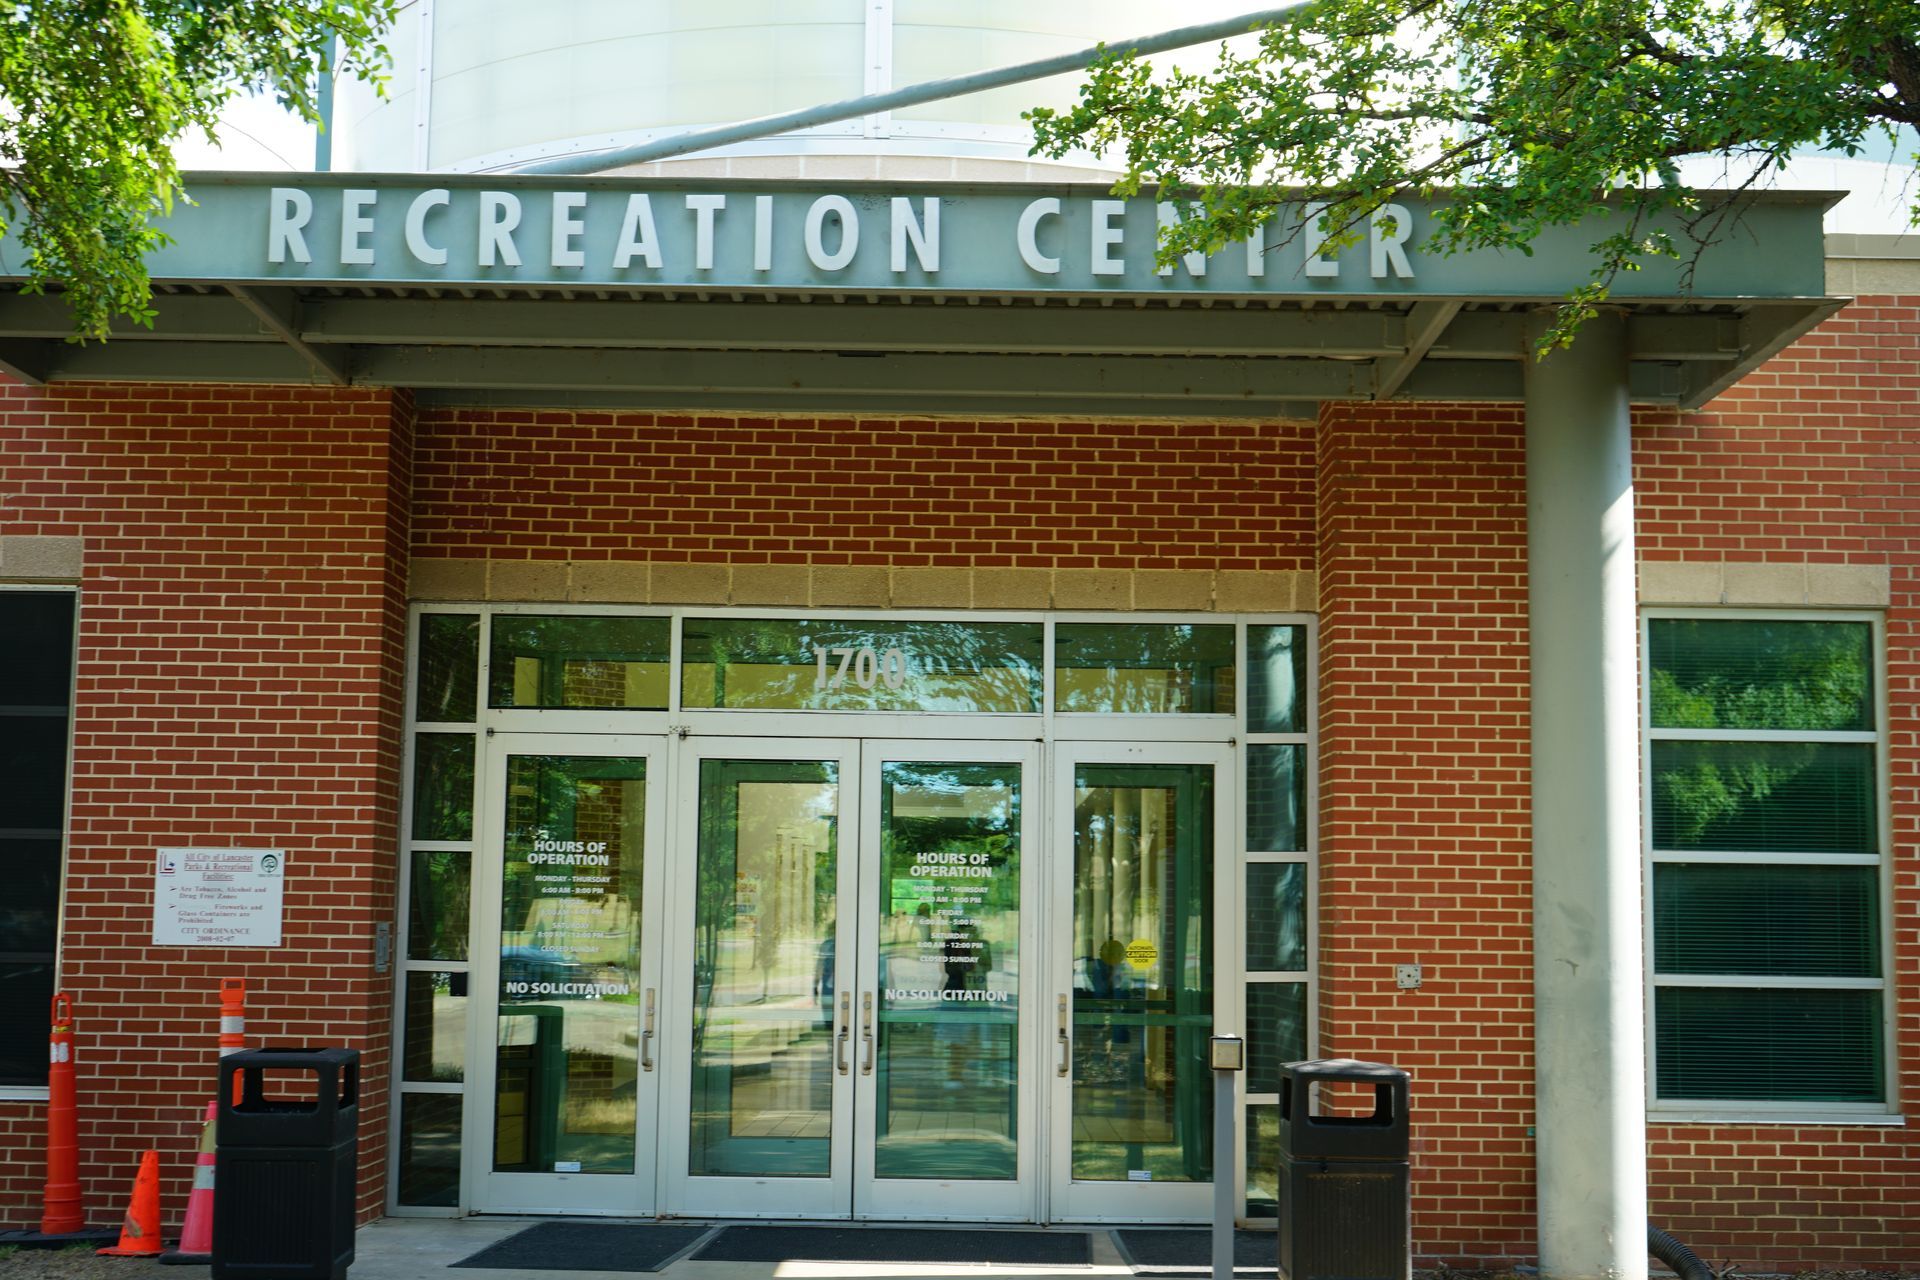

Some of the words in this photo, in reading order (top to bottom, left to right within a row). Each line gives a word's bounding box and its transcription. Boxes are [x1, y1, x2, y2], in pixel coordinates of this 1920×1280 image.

[268, 188, 940, 272] RECREATION
[812, 647, 906, 689] 1700
[534, 840, 584, 852] HOURS
[587, 842, 607, 853] OF
[527, 853, 609, 866] OPERATION
[916, 852, 967, 864] HOURS
[969, 854, 990, 864] OF
[910, 865, 992, 877] OPERATION
[506, 982, 529, 994] NO
[531, 982, 629, 995] SOLICITATION
[885, 989, 907, 1000] NO
[910, 990, 1008, 1001] SOLICITATION
